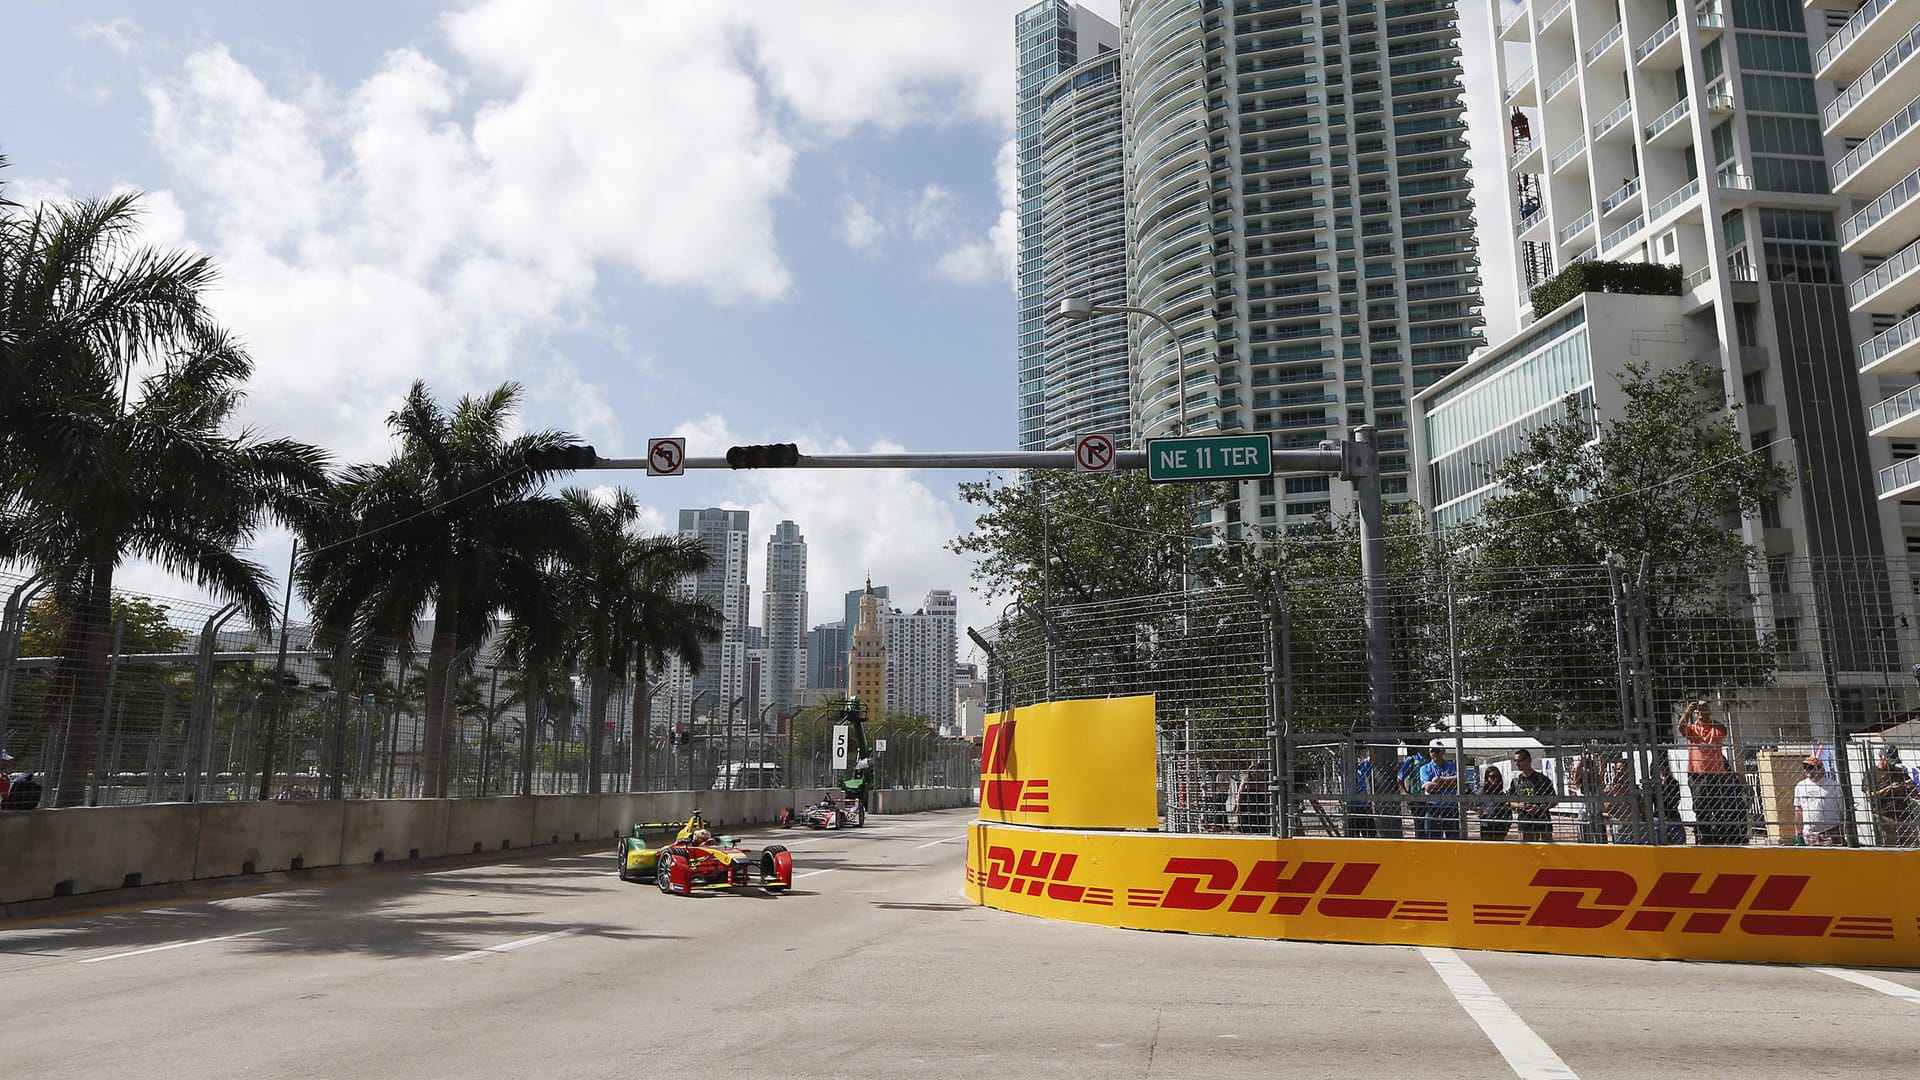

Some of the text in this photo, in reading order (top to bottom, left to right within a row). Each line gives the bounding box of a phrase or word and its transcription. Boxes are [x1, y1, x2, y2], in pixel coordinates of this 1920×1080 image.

[1161, 446, 1258, 469] NE 11 TER
[837, 735, 845, 758] 50
[986, 846, 1086, 903] DHL
[1160, 857, 1397, 919] DHL
[1526, 868, 1833, 937] DHL
